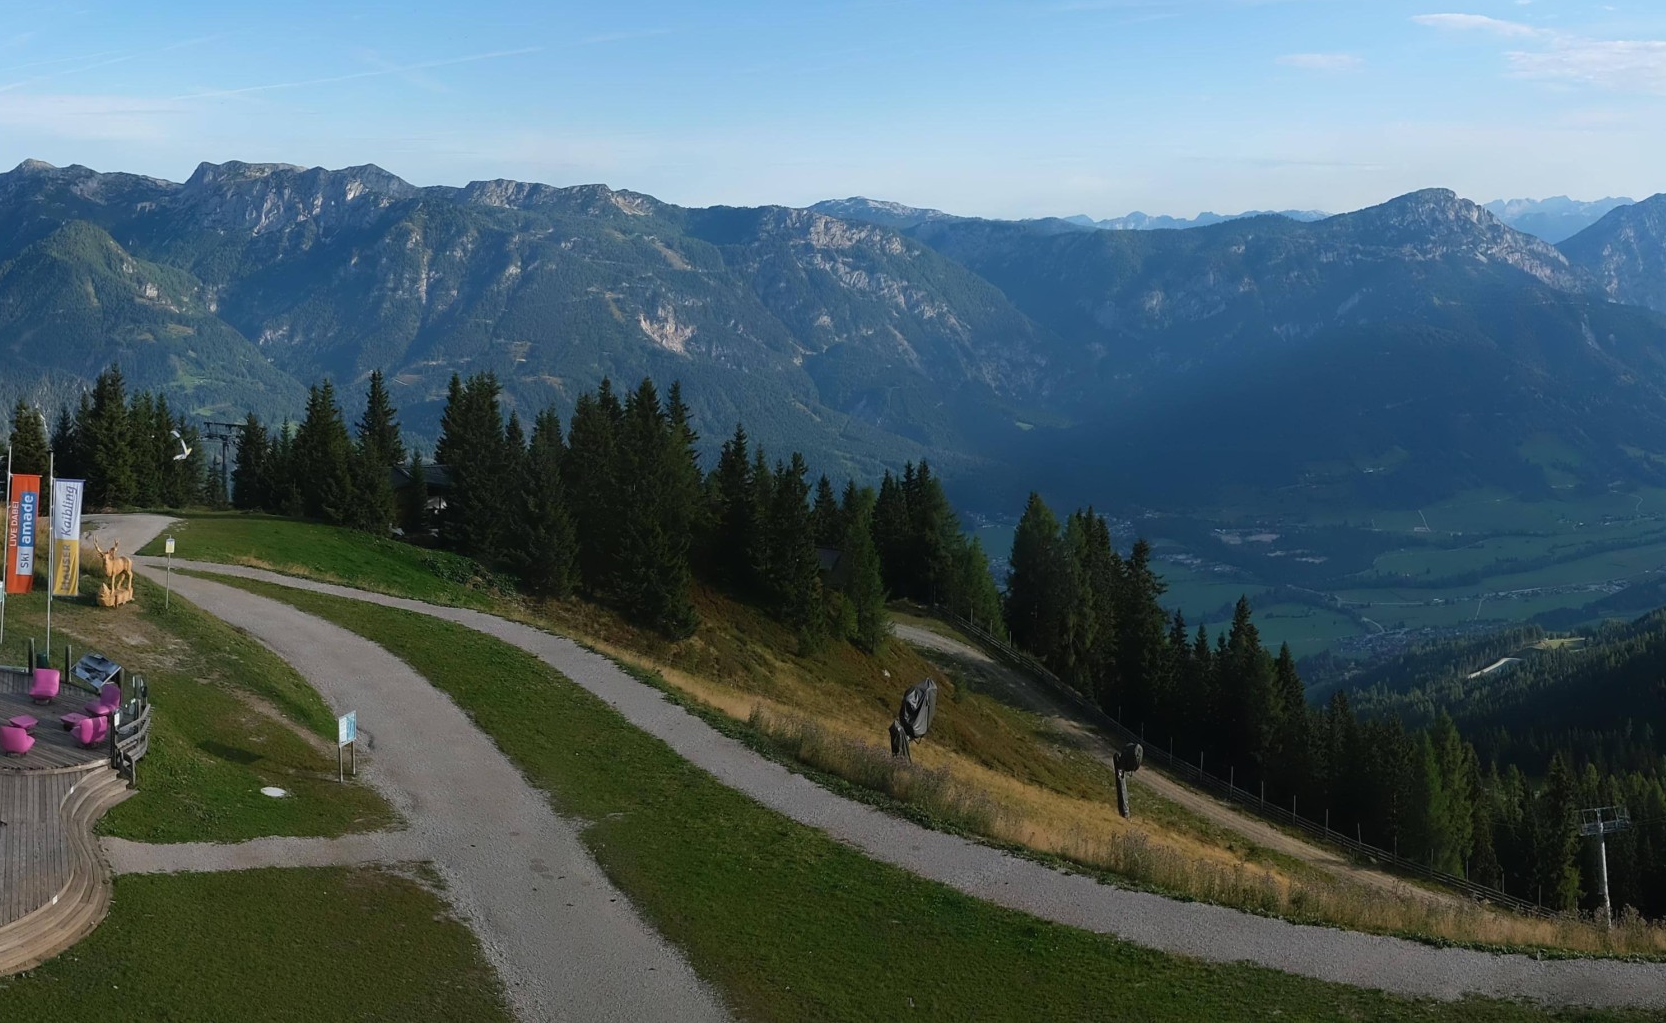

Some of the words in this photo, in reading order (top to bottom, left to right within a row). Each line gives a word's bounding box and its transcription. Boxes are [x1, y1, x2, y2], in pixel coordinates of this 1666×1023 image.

[21, 495, 33, 544] amade
[61, 486, 78, 536] Kaibling
[20, 553, 29, 568] Ski
